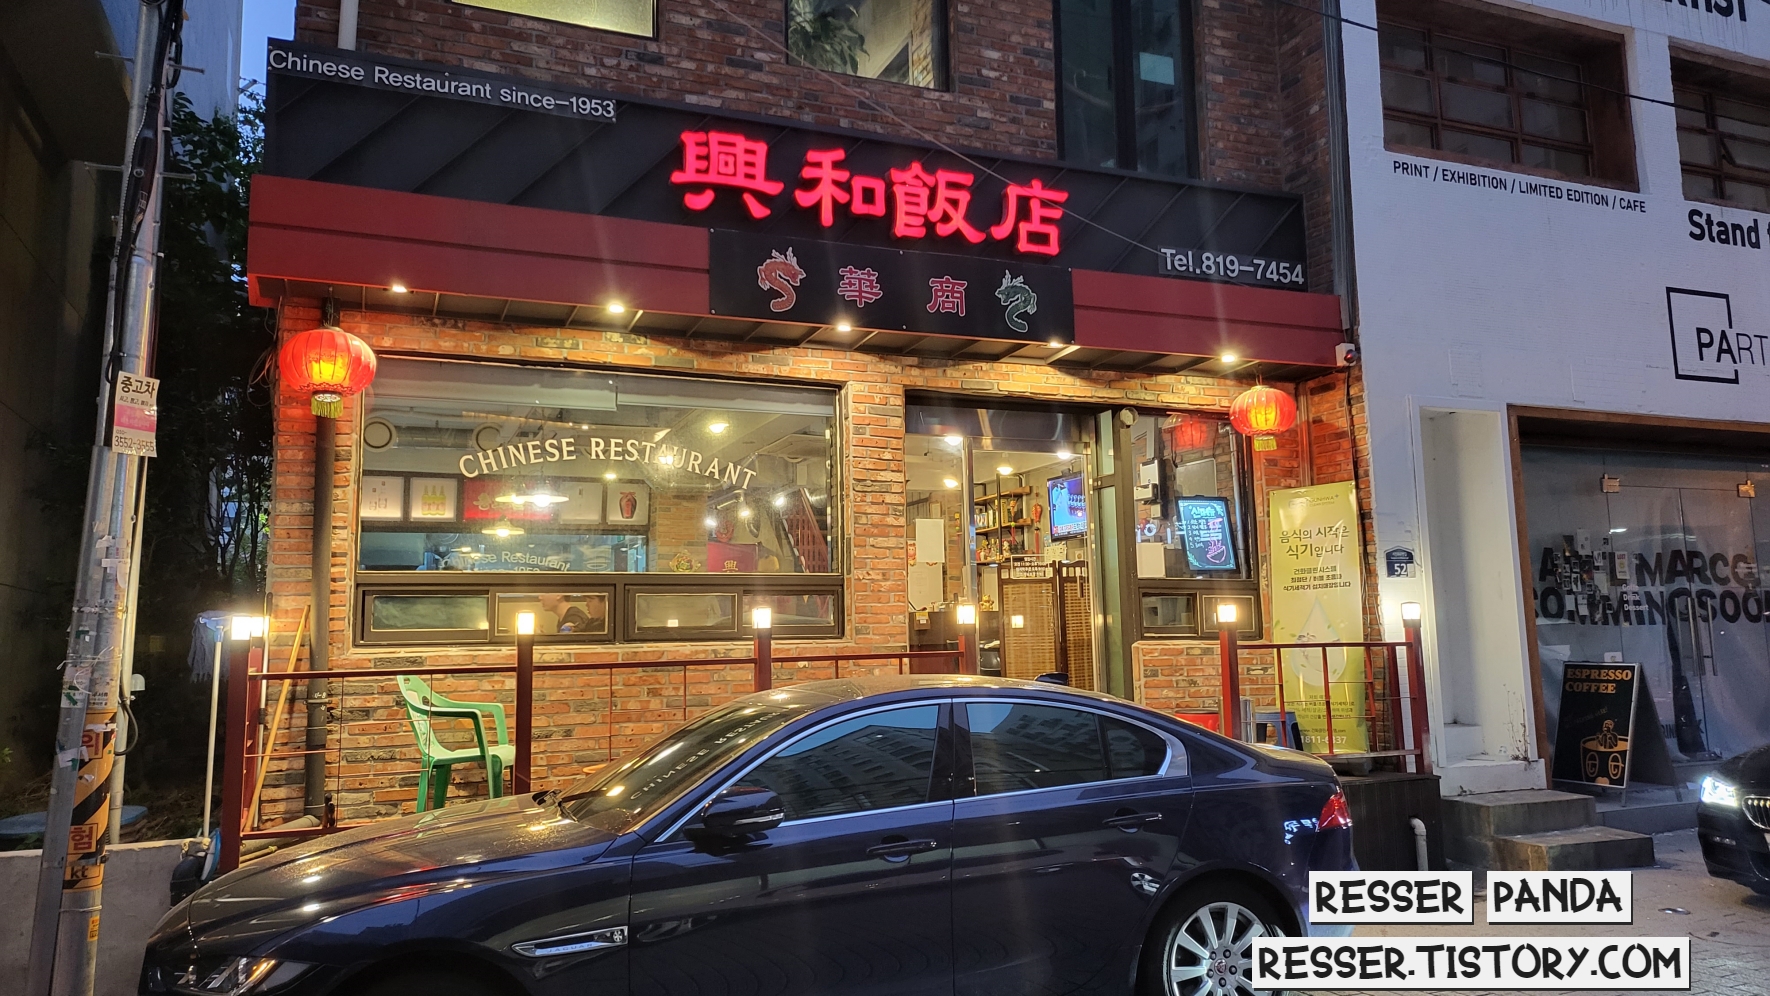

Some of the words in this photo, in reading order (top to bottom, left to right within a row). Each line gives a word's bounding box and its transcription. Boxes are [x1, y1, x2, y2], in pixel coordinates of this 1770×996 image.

[269, 49, 365, 81] Chinese
[374, 65, 492, 99] Restaurant
[670, 130, 1069, 257] 興和飯店
[1393, 160, 1431, 179] PRINT
[1442, 168, 1507, 192] EXHIBITION
[1519, 180, 1563, 200] LIMITED
[1566, 188, 1609, 208] EDITION
[1619, 197, 1647, 213] CAFE
[1687, 208, 1761, 250] Stand
[1160, 248, 1305, 285] Tel.819-7454
[120, 375, 156, 399] 중고차
[458, 437, 578, 478] CHINESE
[590, 437, 758, 491] RESTAURANT
[1279, 529, 1312, 544] 음식의
[1315, 525, 1350, 539] 시작은
[1286, 543, 1345, 560] 식기입니다
[501, 551, 571, 573] Restaurant
[1394, 563, 1408, 575] 52
[1623, 603, 1649, 611] Dessert
[1566, 668, 1632, 681] ESPRESSO
[1565, 682, 1617, 694] COFFEE
[1301, 735, 1347, 744] 1811-637
[70, 865, 89, 879] kt
